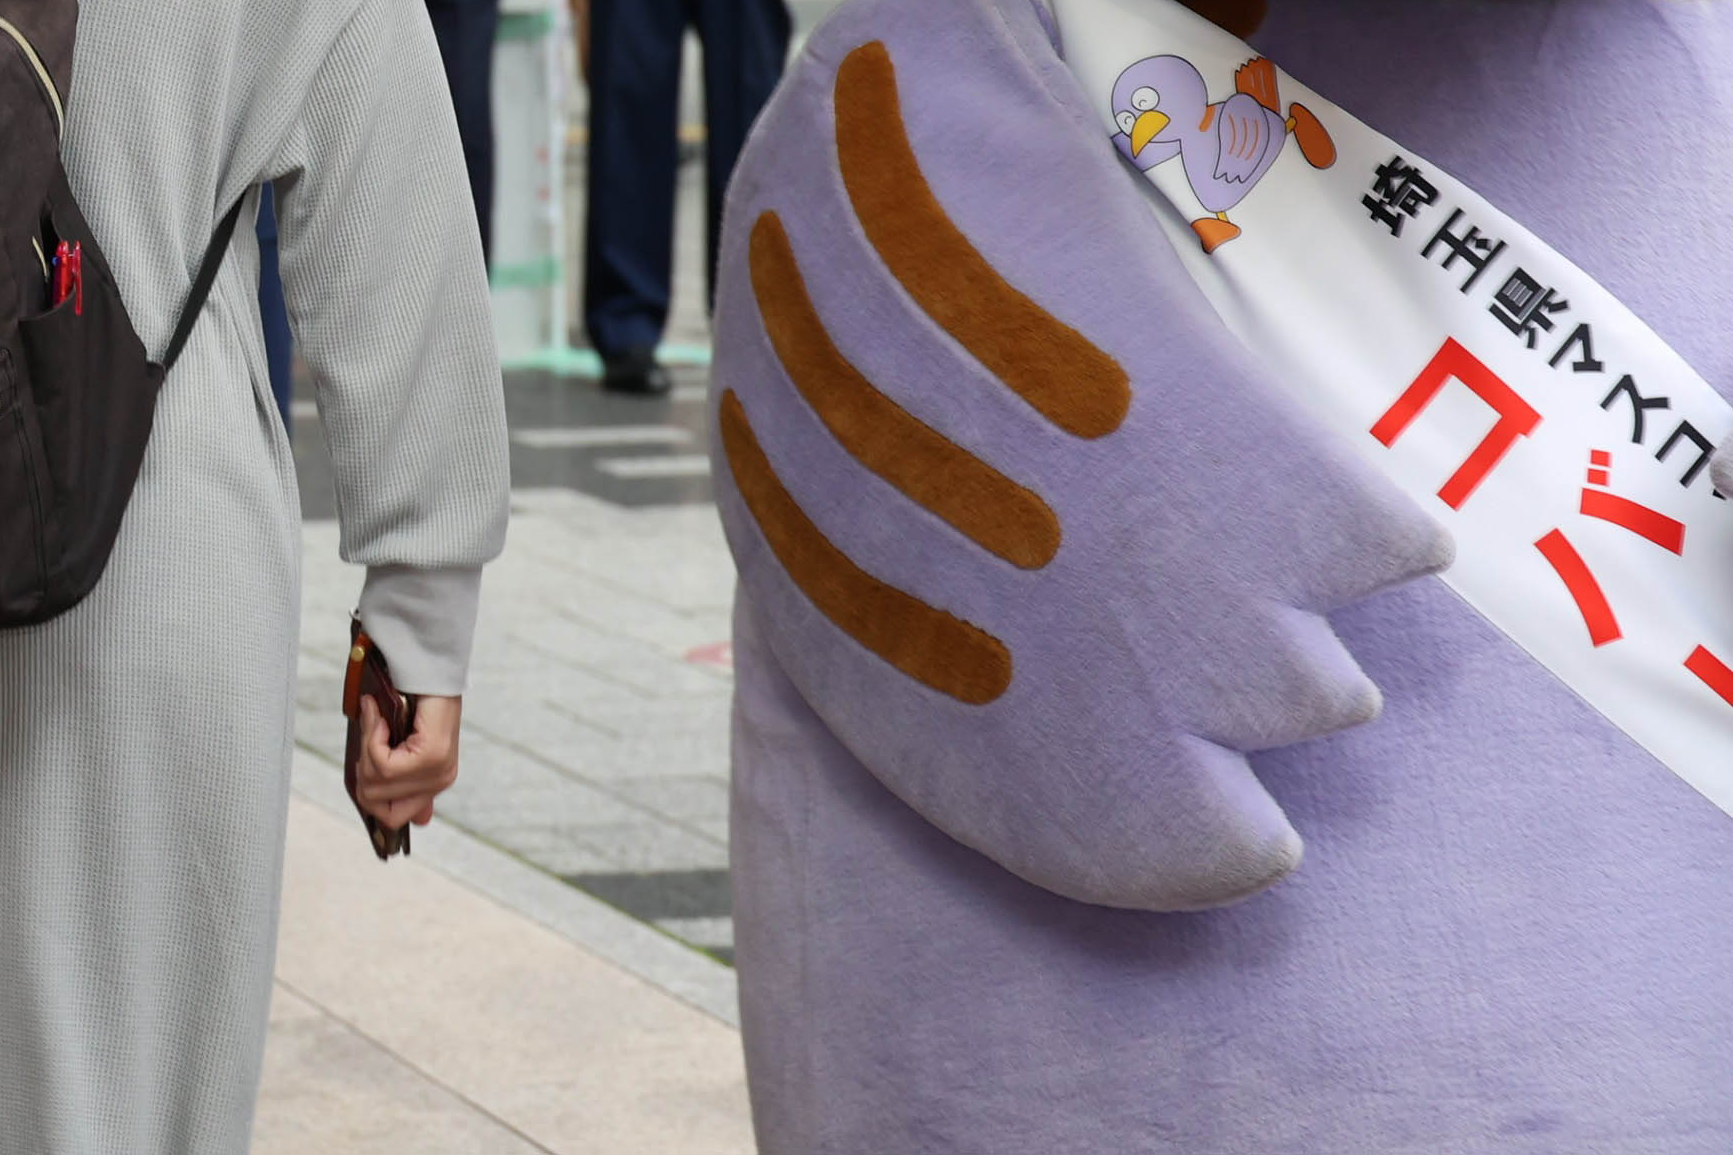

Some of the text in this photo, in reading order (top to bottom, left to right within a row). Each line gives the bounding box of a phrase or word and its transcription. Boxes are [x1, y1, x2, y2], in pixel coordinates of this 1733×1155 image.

[1361, 155, 1729, 501] 埼玉県マスコ
